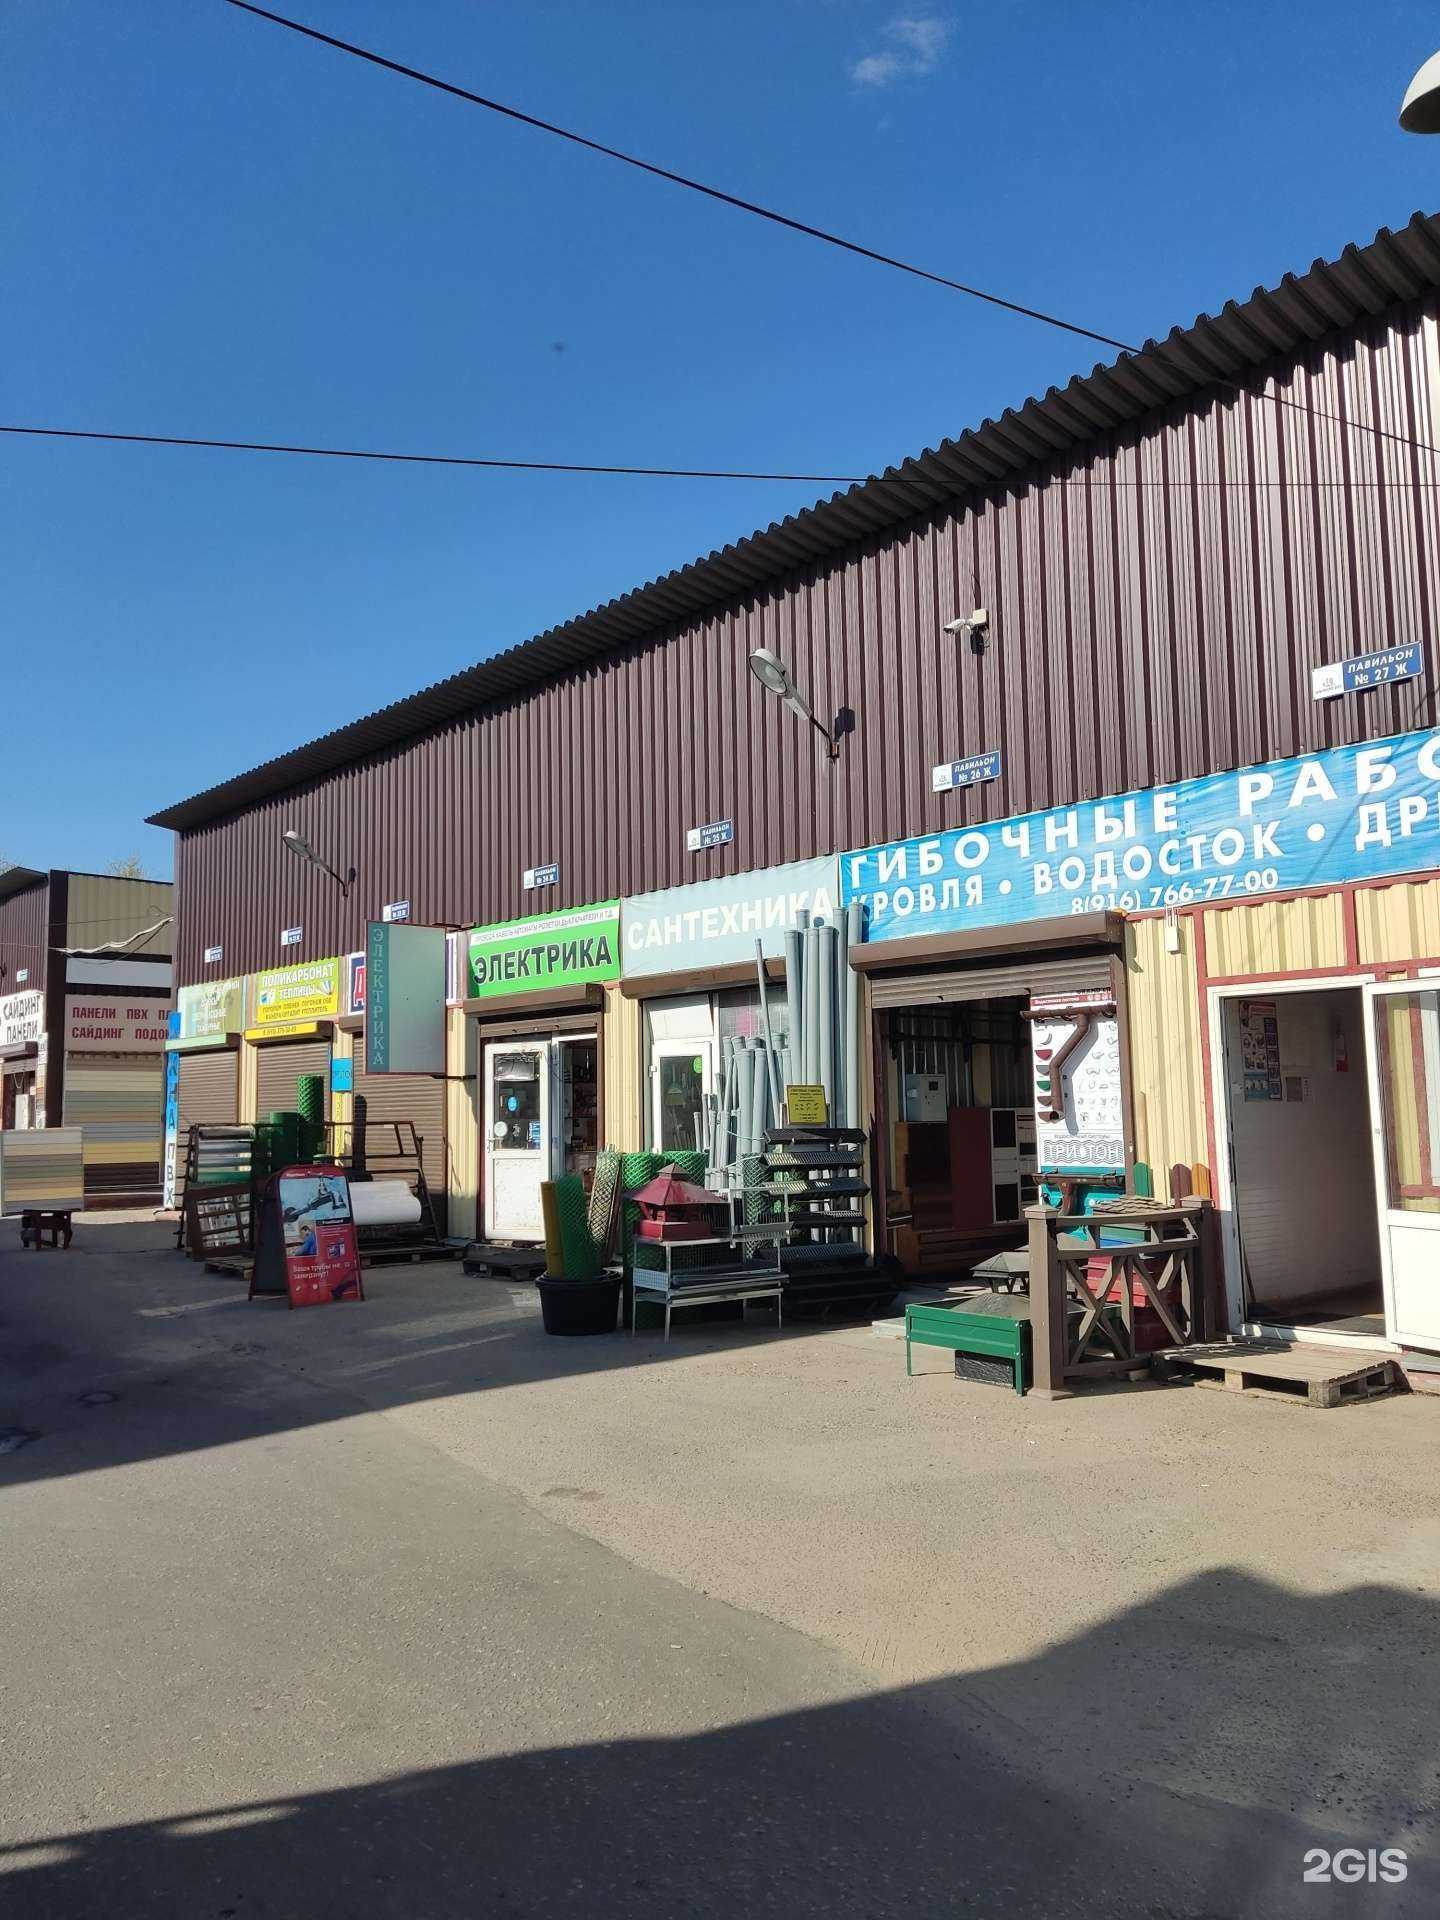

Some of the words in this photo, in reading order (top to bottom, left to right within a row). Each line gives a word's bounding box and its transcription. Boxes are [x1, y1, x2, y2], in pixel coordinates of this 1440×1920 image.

[1348, 648, 1413, 673] ПАВИЛЬОН
[1355, 674, 1369, 685] №
[1374, 667, 1389, 681] 27
[1395, 661, 1408, 675] Ж
[954, 756, 996, 773] ПАВИЛЬОН
[970, 768, 981, 780] 26
[983, 766, 992, 777] Ж
[712, 833, 720, 842] 25
[850, 792, 1178, 889] ГИБОЧНЫЕ
[851, 874, 984, 921] РОВЛЯ
[1033, 820, 1285, 896] ВОДОСТОК
[1354, 793, 1440, 852] ДР
[1070, 888, 1141, 915] 8(916)
[1149, 867, 1279, 907] 766-77-00
[626, 886, 833, 951] САНТЕХНИКА
[473, 934, 613, 984] ЭЛЕКТРИКА
[262, 963, 335, 988] ПОЛИКАРБОНАТ
[3, 995, 41, 1021] САЙДИНГ
[372, 928, 385, 1065] ЭЛЕКТРИКА
[72, 1006, 117, 1020] ПАНЕЛИ
[126, 1008, 148, 1020] ПВХ
[6, 1020, 38, 1043] ПАНЕЛИ
[71, 1024, 125, 1041] САЙДИНГ
[165, 1143, 176, 1205] ПВХ
